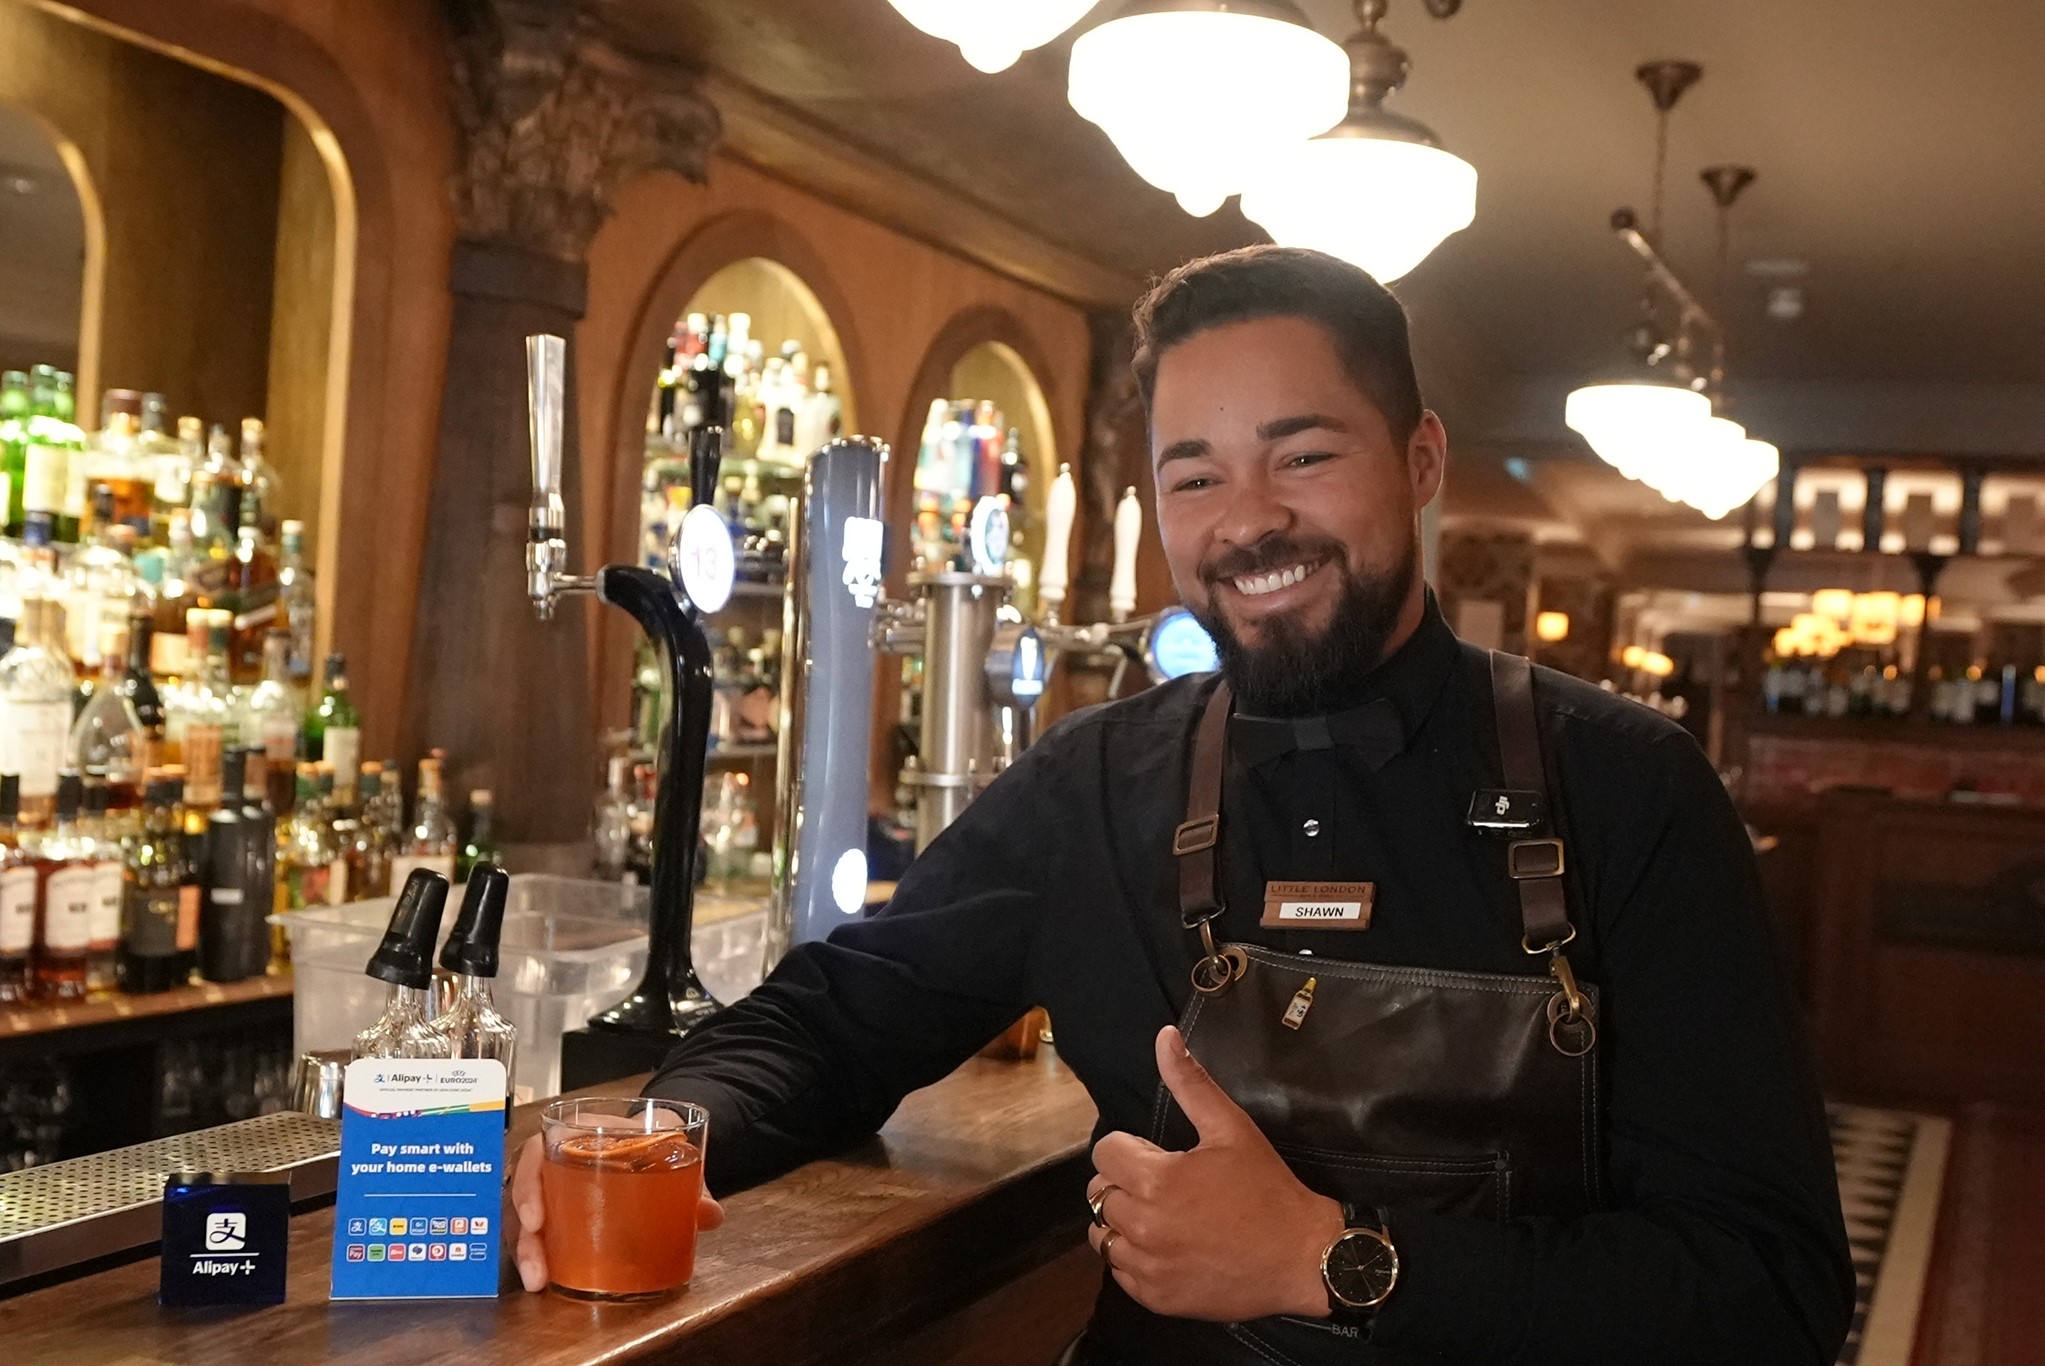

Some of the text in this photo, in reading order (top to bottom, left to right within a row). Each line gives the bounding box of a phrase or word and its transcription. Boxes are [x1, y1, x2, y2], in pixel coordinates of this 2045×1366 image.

[691, 546, 717, 580] 13
[1495, 795, 1510, 815] dji
[1271, 885, 1366, 894] LITTLE LONDON
[1295, 907, 1344, 917] SHAWN
[371, 1143, 474, 1156] Pay smart with
[351, 1161, 493, 1175] your home e-wallets
[1331, 1324, 1359, 1338] BAR
